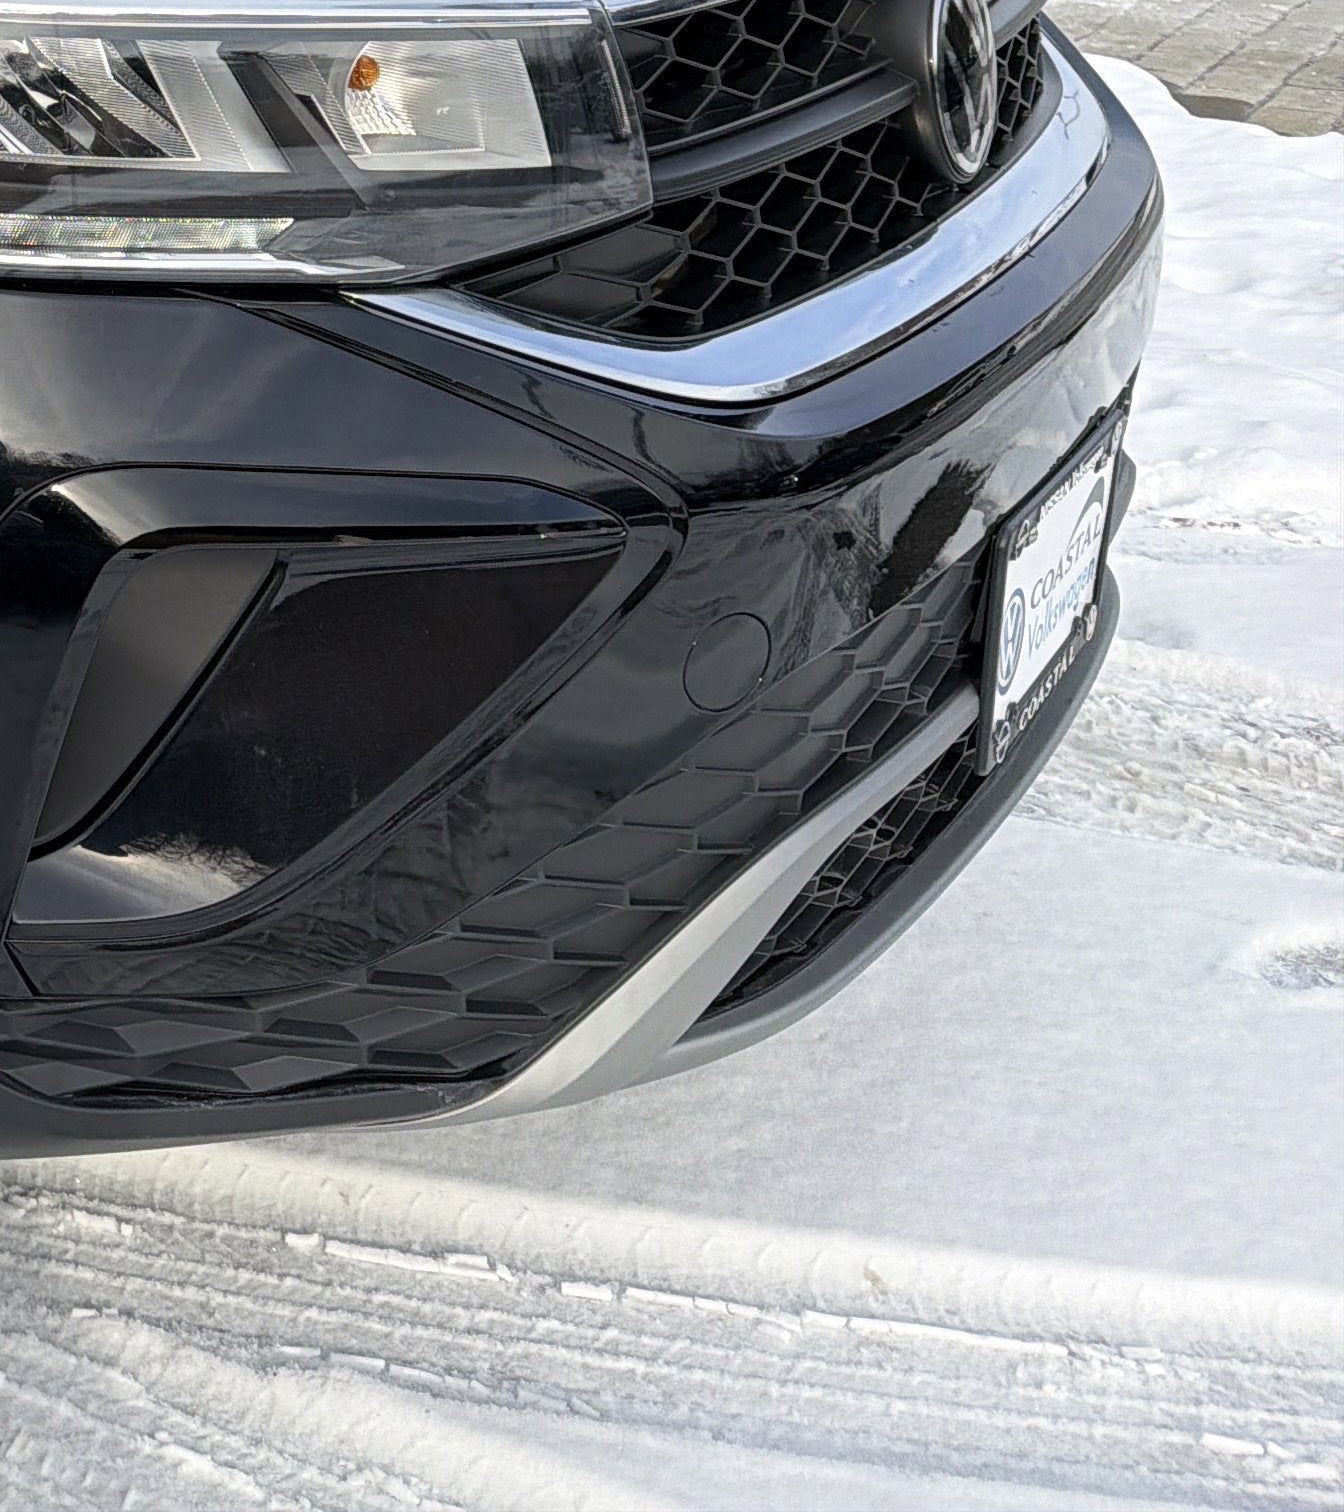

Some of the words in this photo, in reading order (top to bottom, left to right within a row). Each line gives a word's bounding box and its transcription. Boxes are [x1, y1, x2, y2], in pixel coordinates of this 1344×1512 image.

[1028, 556, 1096, 658] Volkswagen
[1030, 511, 1102, 610] COASTAL
[1018, 645, 1076, 731] COASTAL
